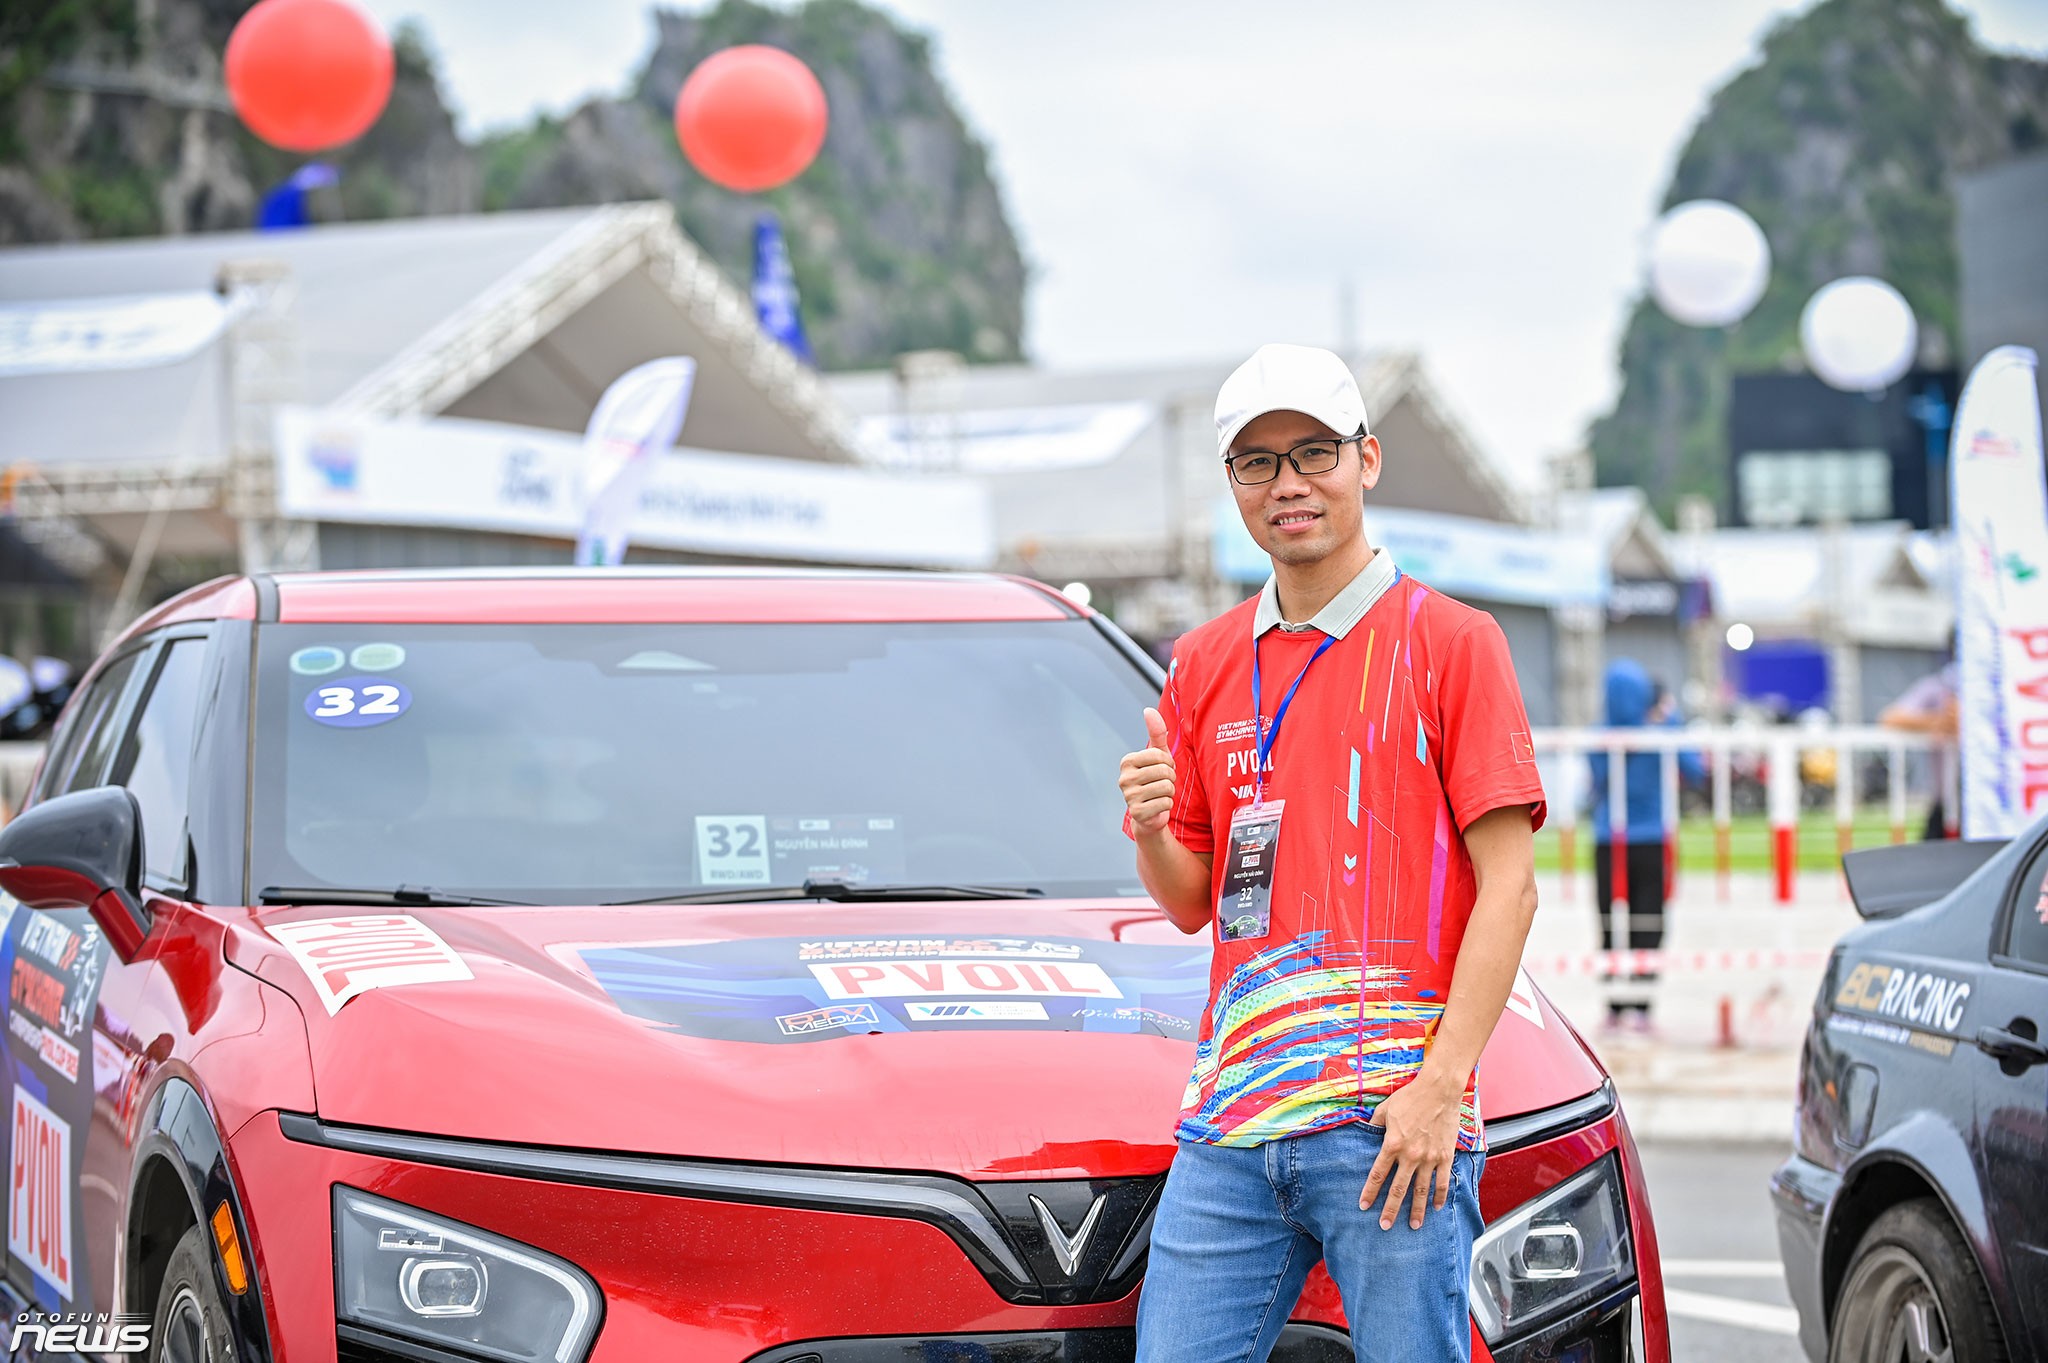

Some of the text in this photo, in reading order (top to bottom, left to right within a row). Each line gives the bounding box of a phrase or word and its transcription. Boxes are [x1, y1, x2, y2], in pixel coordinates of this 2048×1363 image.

[314, 685, 400, 717] 32
[1217, 720, 1248, 731] VIETNAM
[706, 823, 762, 858] 32
[710, 869, 764, 880] RWD/AWD
[1239, 886, 1253, 902] 32
[281, 919, 450, 996] PVOIL
[799, 939, 946, 952] VIETNAM
[830, 963, 1102, 994] PVOIL
[1835, 961, 1971, 1033] BC RACING
[788, 1014, 870, 1033] MEDIA
[13, 1101, 68, 1285] PVOIL
